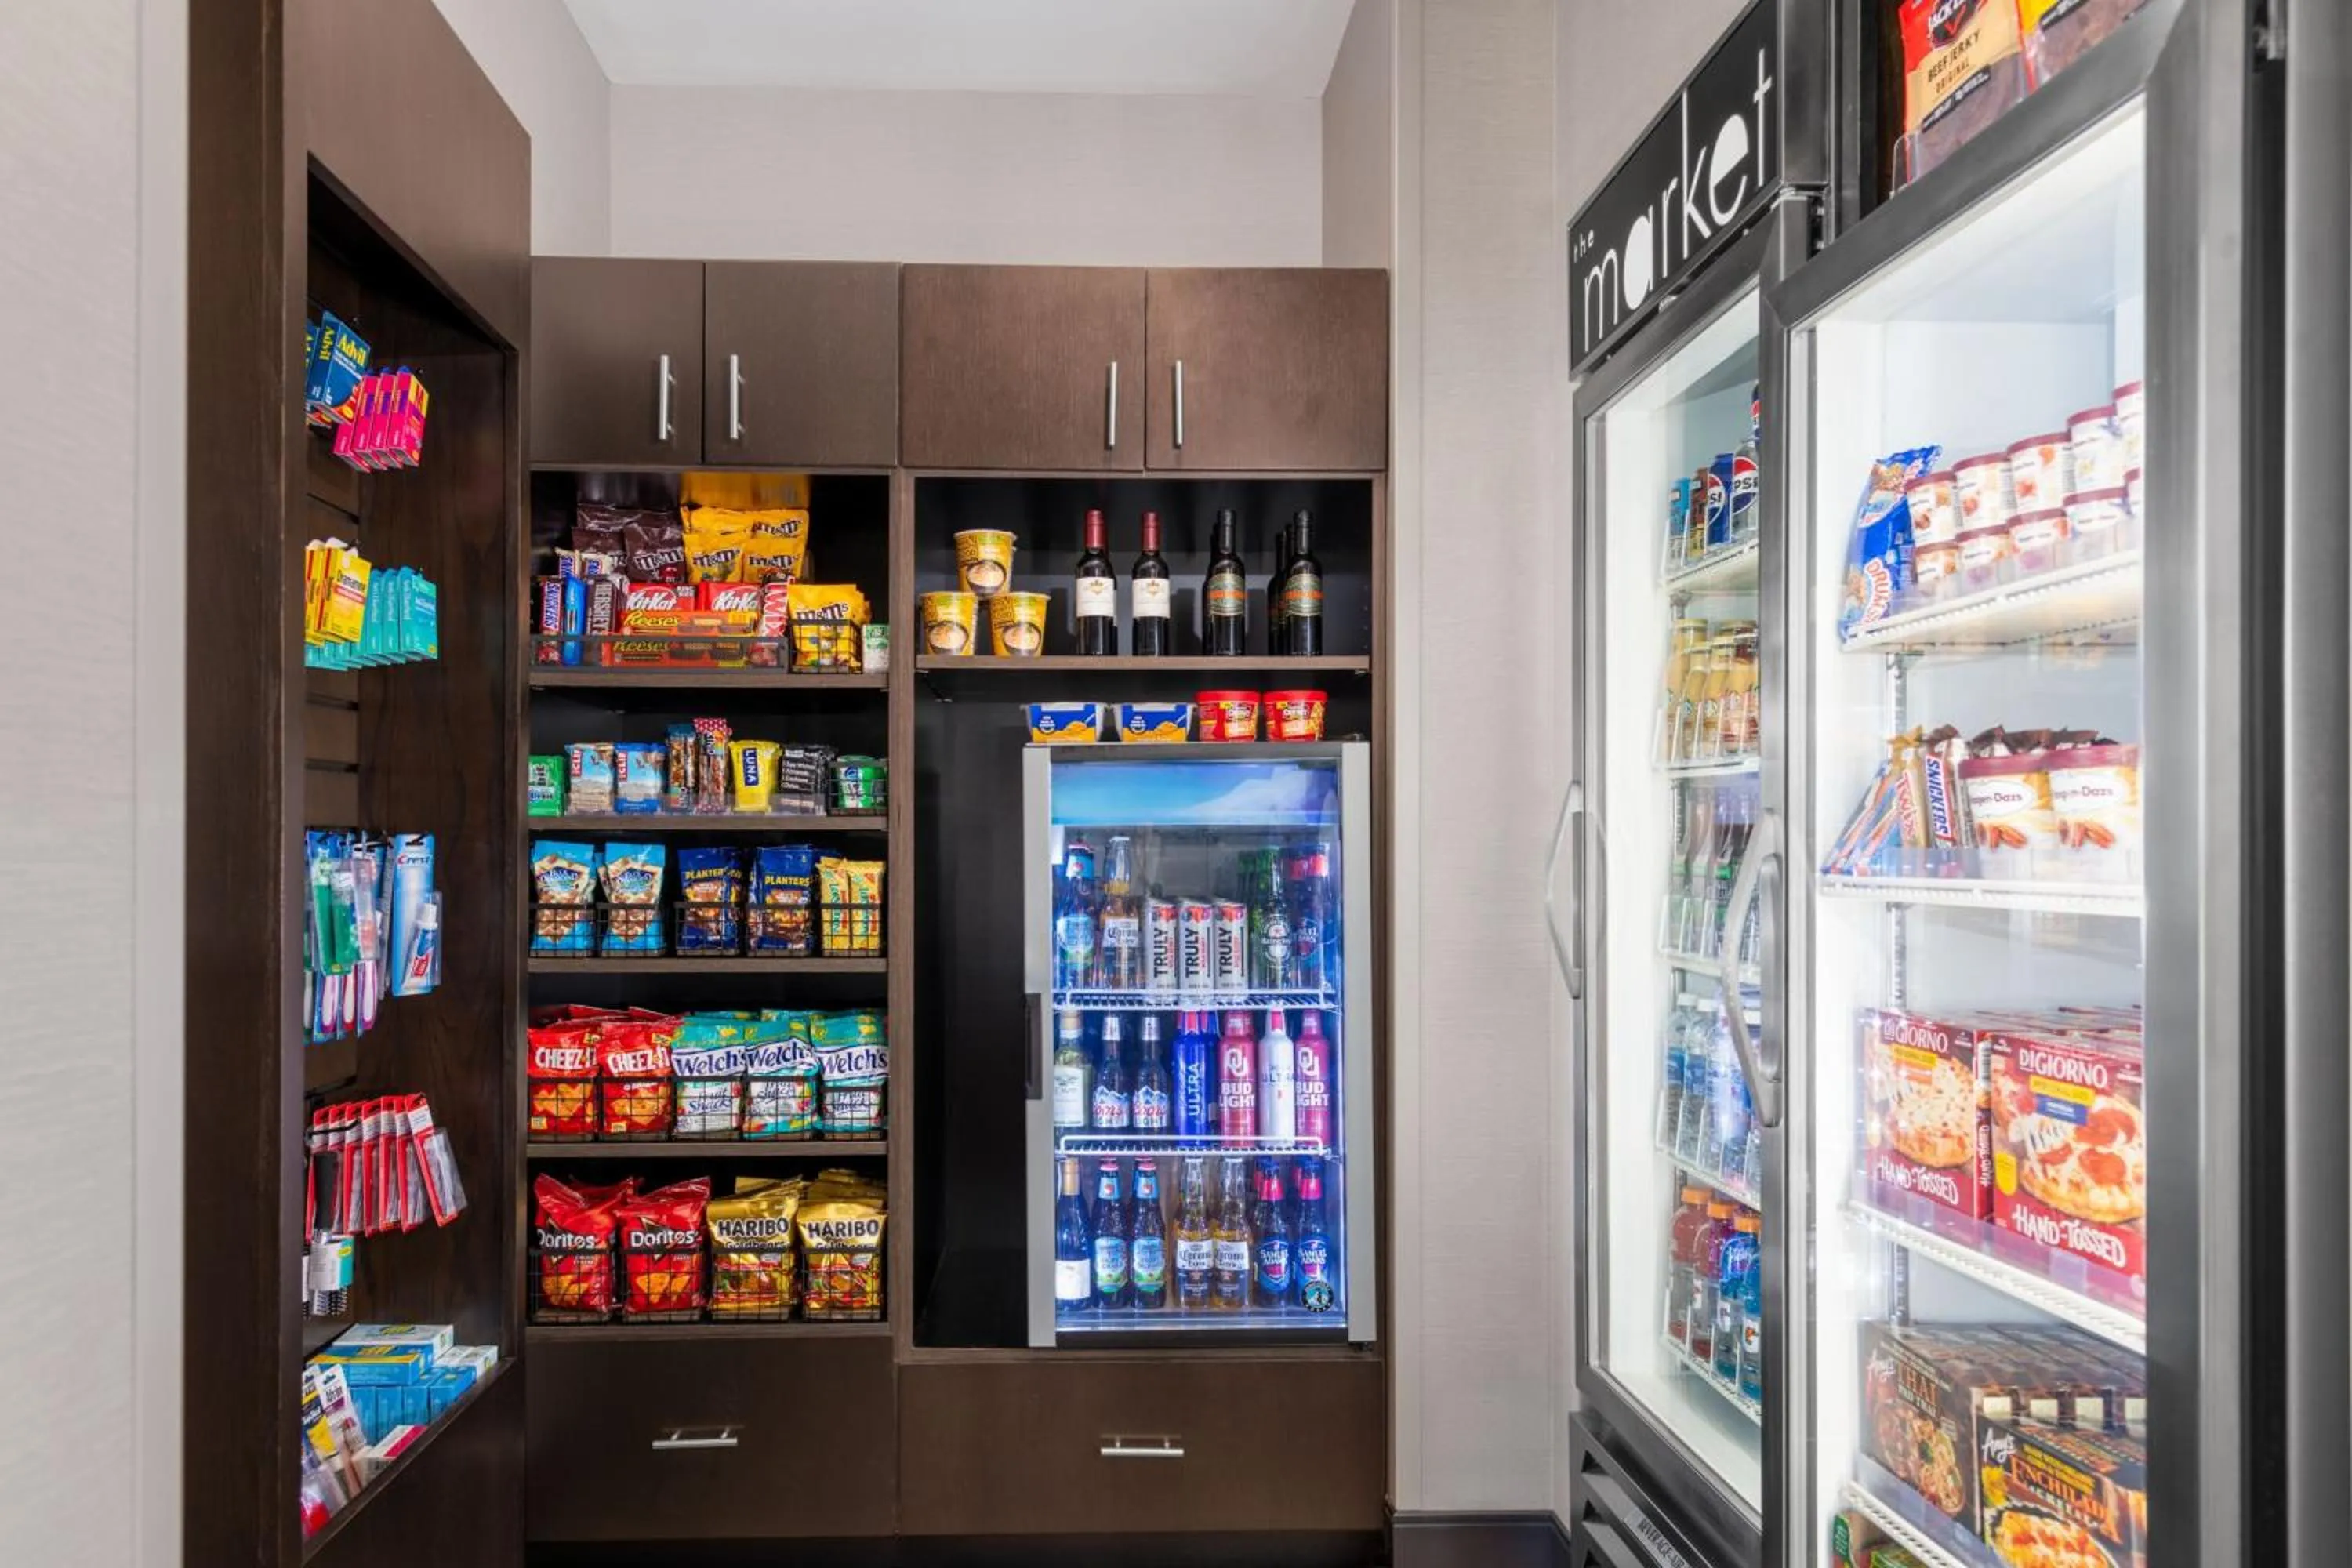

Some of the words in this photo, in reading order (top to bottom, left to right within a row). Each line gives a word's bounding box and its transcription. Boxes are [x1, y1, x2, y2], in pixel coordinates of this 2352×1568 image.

[1928, 54, 1948, 82] BEEF
[1949, 28, 1982, 65] JERKY
[1584, 49, 1772, 352] market
[1574, 230, 1594, 263] the
[338, 333, 367, 366] Advil
[745, 750, 757, 783] LUNA
[1926, 757, 1950, 836] SNICKERS
[397, 854, 432, 866] Crest
[765, 876, 810, 887] PLANTERS
[1153, 927, 1168, 978] TRULY
[1185, 927, 1200, 978] TRULY
[1218, 927, 1232, 978] TRULY
[824, 1051, 888, 1074] Welch's
[1188, 1062, 1200, 1116] ULTRA
[1219, 1094, 1254, 1108] LIGHT
[1221, 1082, 1253, 1094] BUD
[1879, 1156, 1958, 1205] HAND-TOSSED
[538, 1228, 597, 1248] Doritos
[630, 1229, 695, 1248] Doritos
[718, 1217, 790, 1237] HARIBO
[808, 1219, 880, 1238] HARIBO
[2010, 1203, 2127, 1268] HAND-TOSSED
[1982, 1427, 2016, 1464] Amy's
